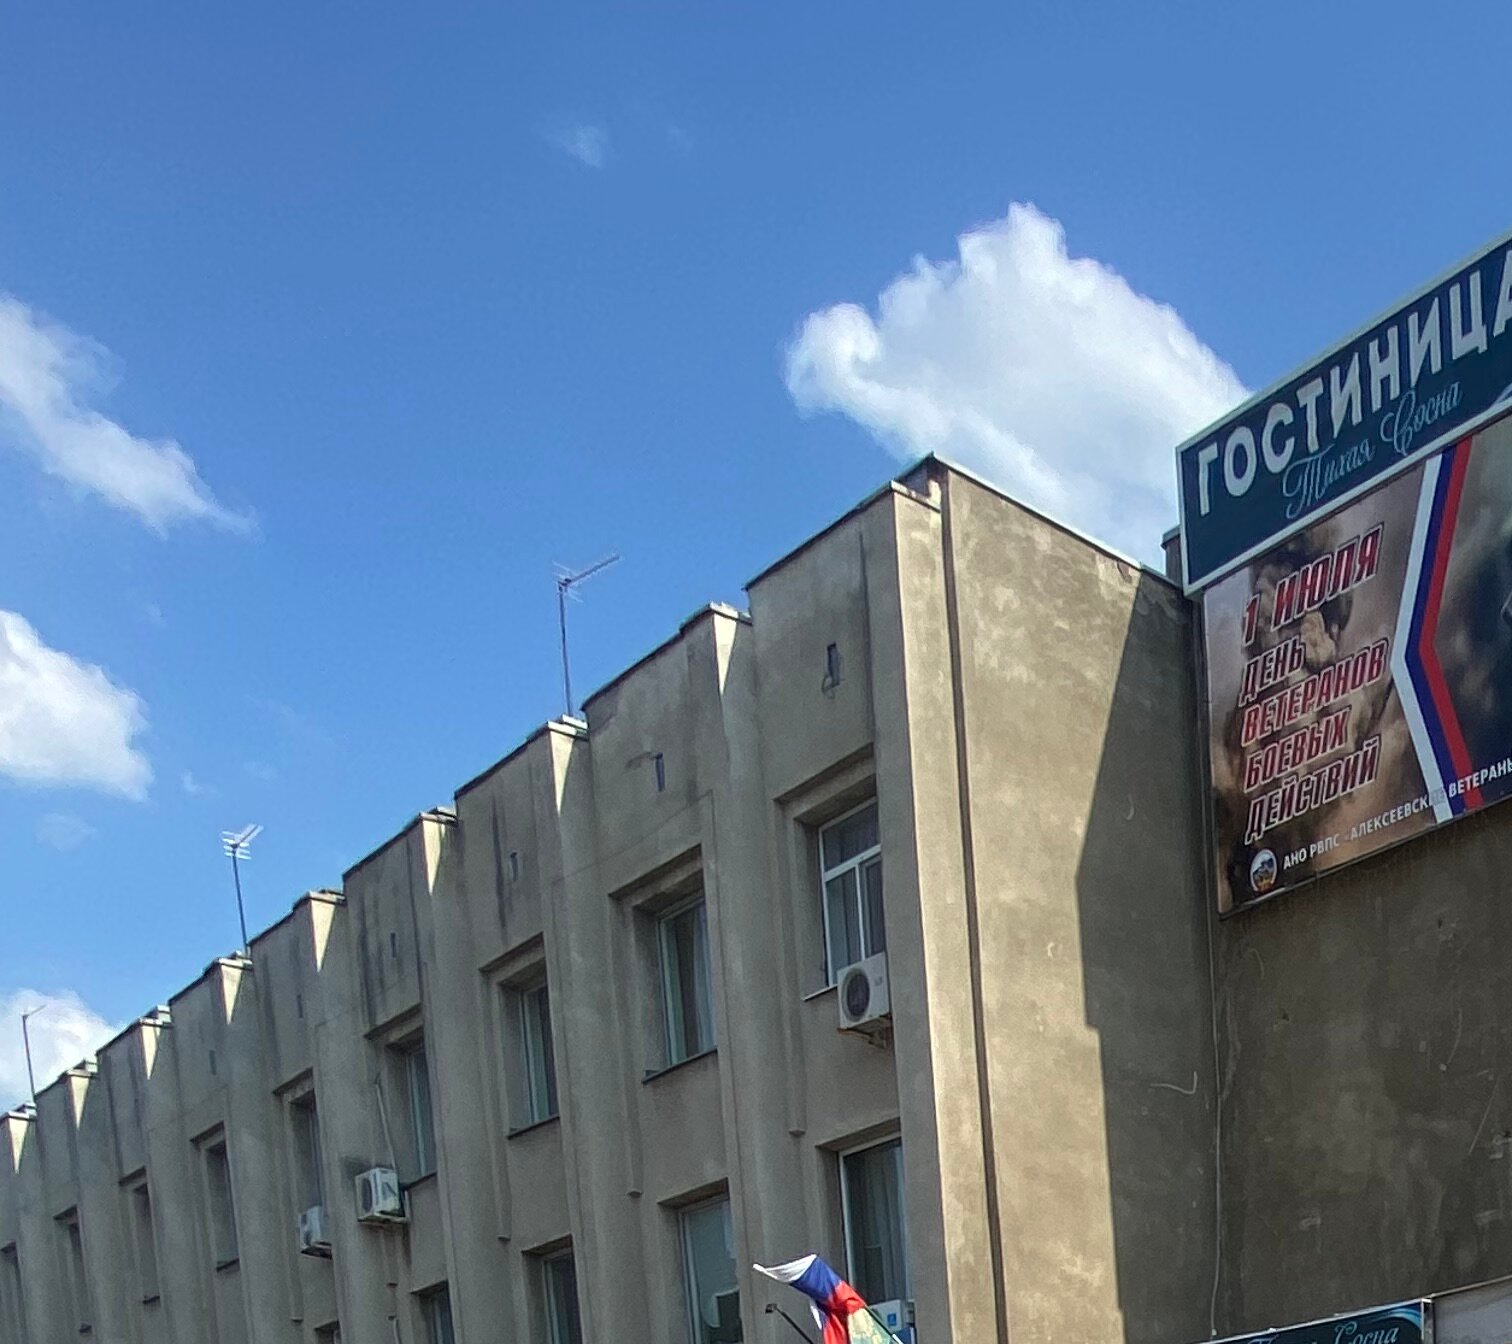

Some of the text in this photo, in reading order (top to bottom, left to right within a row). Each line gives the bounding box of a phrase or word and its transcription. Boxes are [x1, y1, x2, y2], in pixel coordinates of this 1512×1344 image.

[1282, 381, 1463, 520] Тихая Сосна
[1242, 523, 1384, 647] 1 ИЮЛЯ
[1238, 636, 1305, 707] ДЕНЬ
[1240, 637, 1389, 749] ВЕТЕРАНОВ
[1243, 704, 1354, 794] БОЕВЫХ
[1244, 735, 1381, 845] ДЕЙСТВИЙ
[1283, 846, 1308, 870] АНО
[1309, 834, 1340, 859] РВПС
